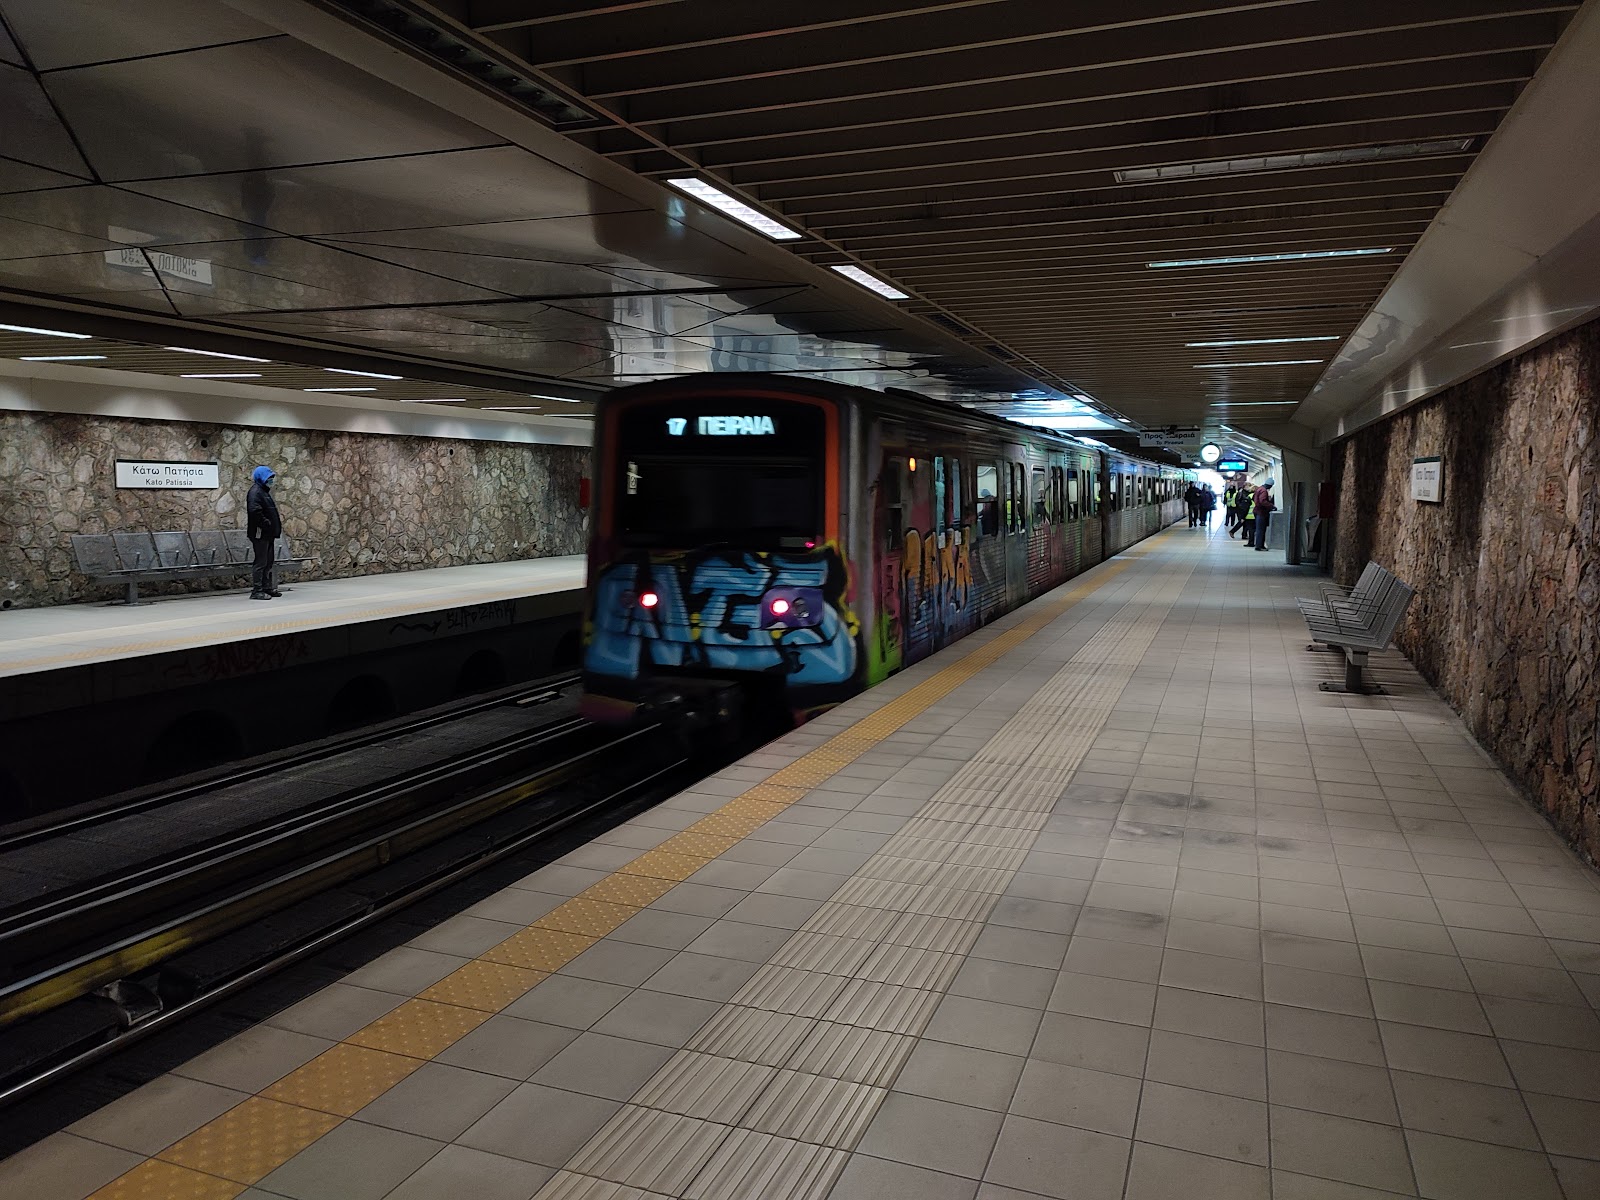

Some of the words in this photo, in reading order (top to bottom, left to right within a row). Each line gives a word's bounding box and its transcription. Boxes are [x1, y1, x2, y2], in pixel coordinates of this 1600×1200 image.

[132, 465, 160, 475] Κάτω
[164, 466, 204, 477] Πατήσια
[145, 478, 163, 486] Kato
[165, 478, 193, 486] Patissia
